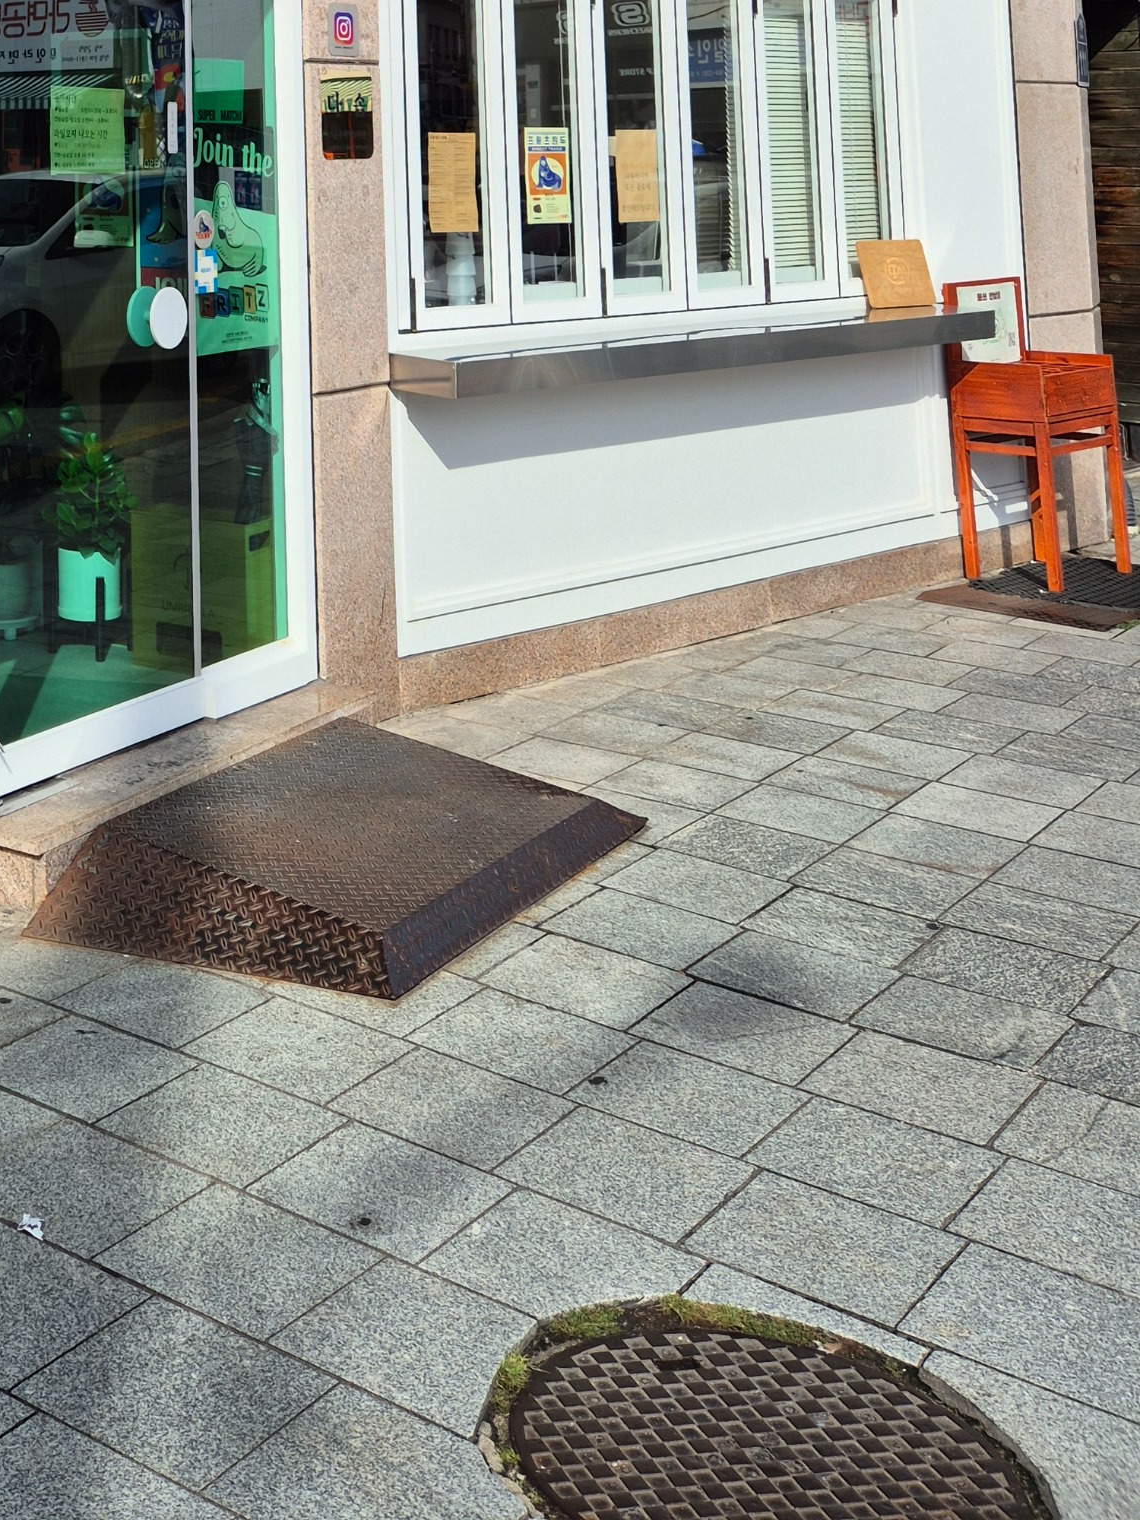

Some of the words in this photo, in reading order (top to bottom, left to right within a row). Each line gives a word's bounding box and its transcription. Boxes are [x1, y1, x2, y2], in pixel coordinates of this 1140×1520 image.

[198, 109, 216, 121] SUPER
[193, 127, 234, 168] Join
[242, 141, 274, 178] the
[202, 290, 266, 315] FRITZ
